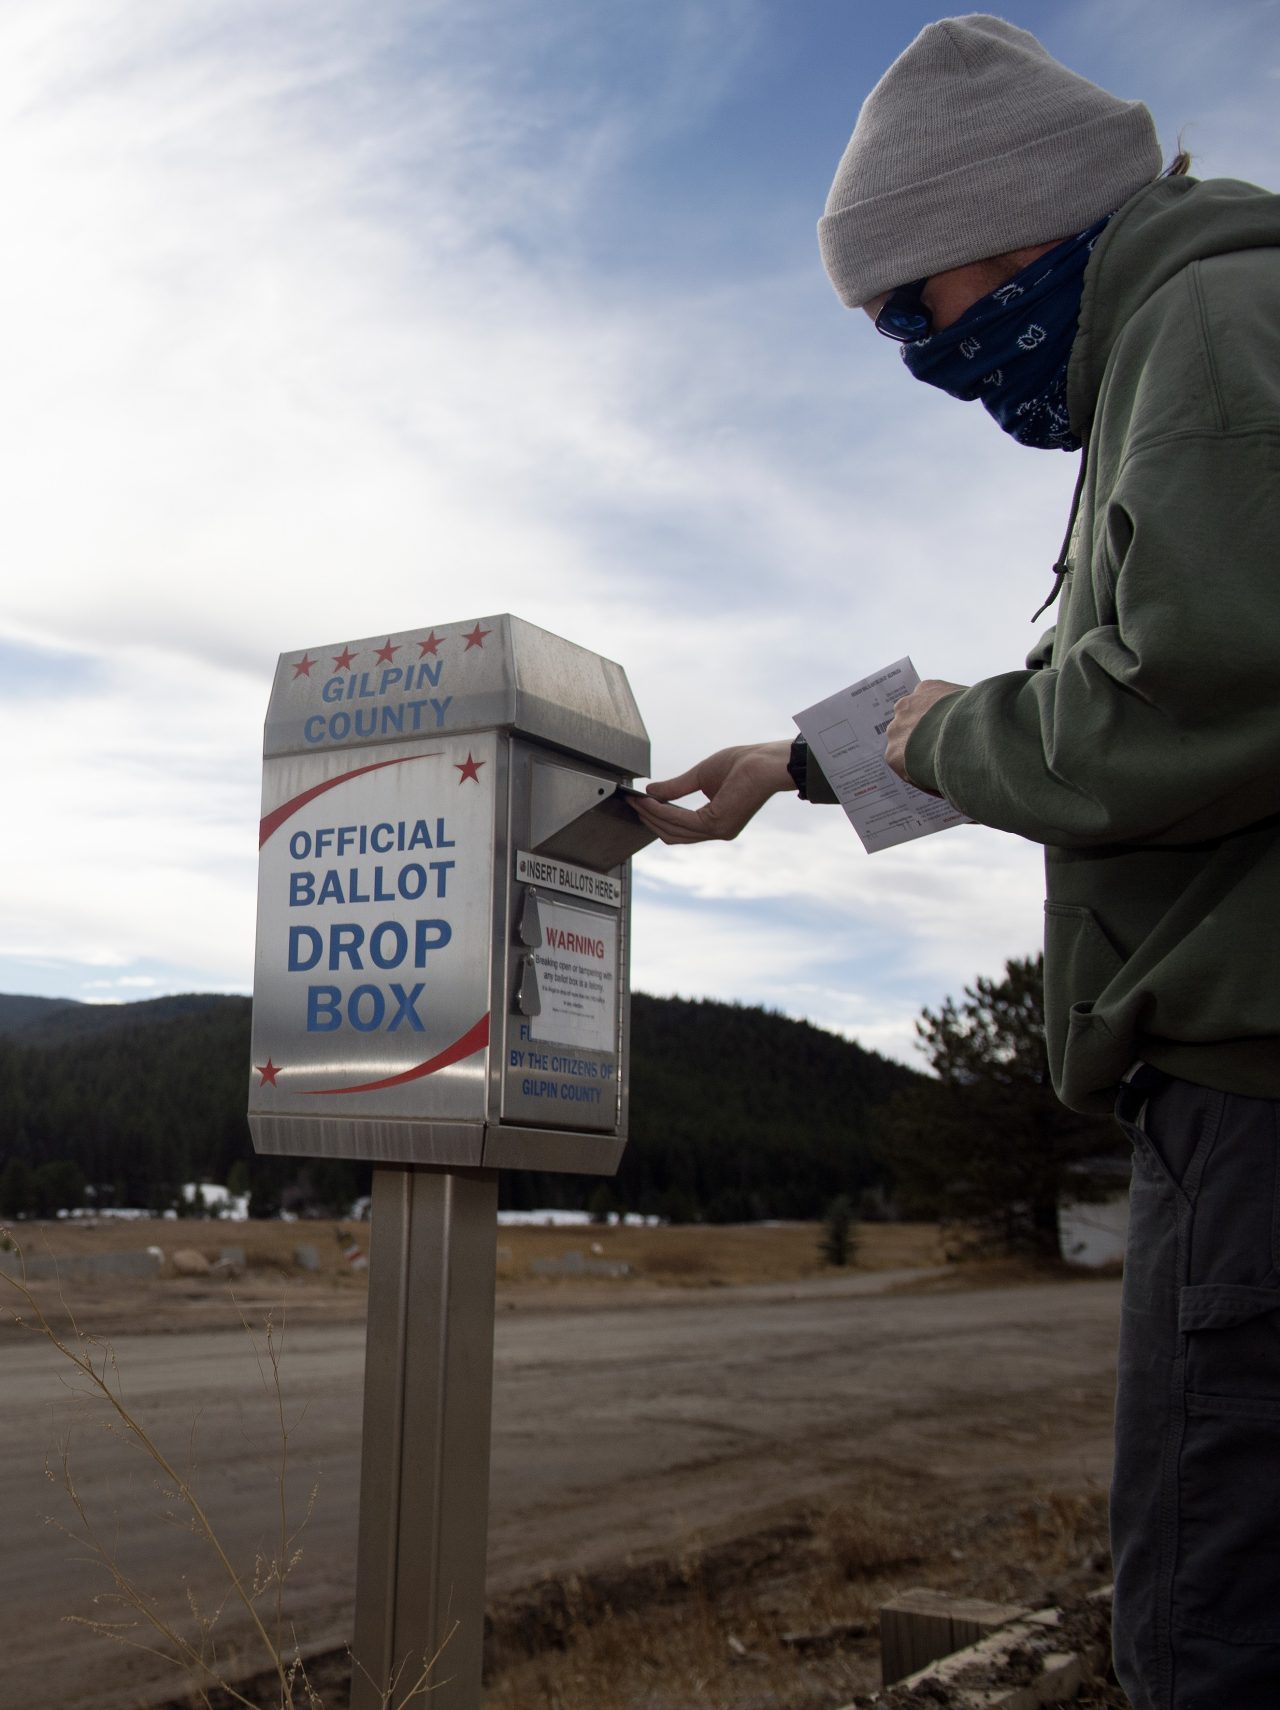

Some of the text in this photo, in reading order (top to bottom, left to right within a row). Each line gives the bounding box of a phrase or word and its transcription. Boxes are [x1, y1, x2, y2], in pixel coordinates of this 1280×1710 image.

[322, 660, 444, 703] GILPIN
[304, 696, 453, 743] COUNTY
[289, 817, 455, 860] OFFICIAL
[289, 860, 455, 907] BALLOT
[527, 860, 613, 899] INSERT BALLOTS HERE
[288, 919, 452, 973] DROP
[535, 954, 558, 970] Breaking
[559, 961, 572, 973] open
[573, 964, 579, 972] or
[546, 926, 605, 960] WARNING
[543, 972, 553, 983] any
[554, 973, 569, 984] ballot
[569, 977, 578, 986] box
[306, 982, 426, 1032] BOX
[510, 1050, 614, 1080] BY THE CITIZENS OF
[522, 1079, 602, 1104] GILPIN COUNTY
